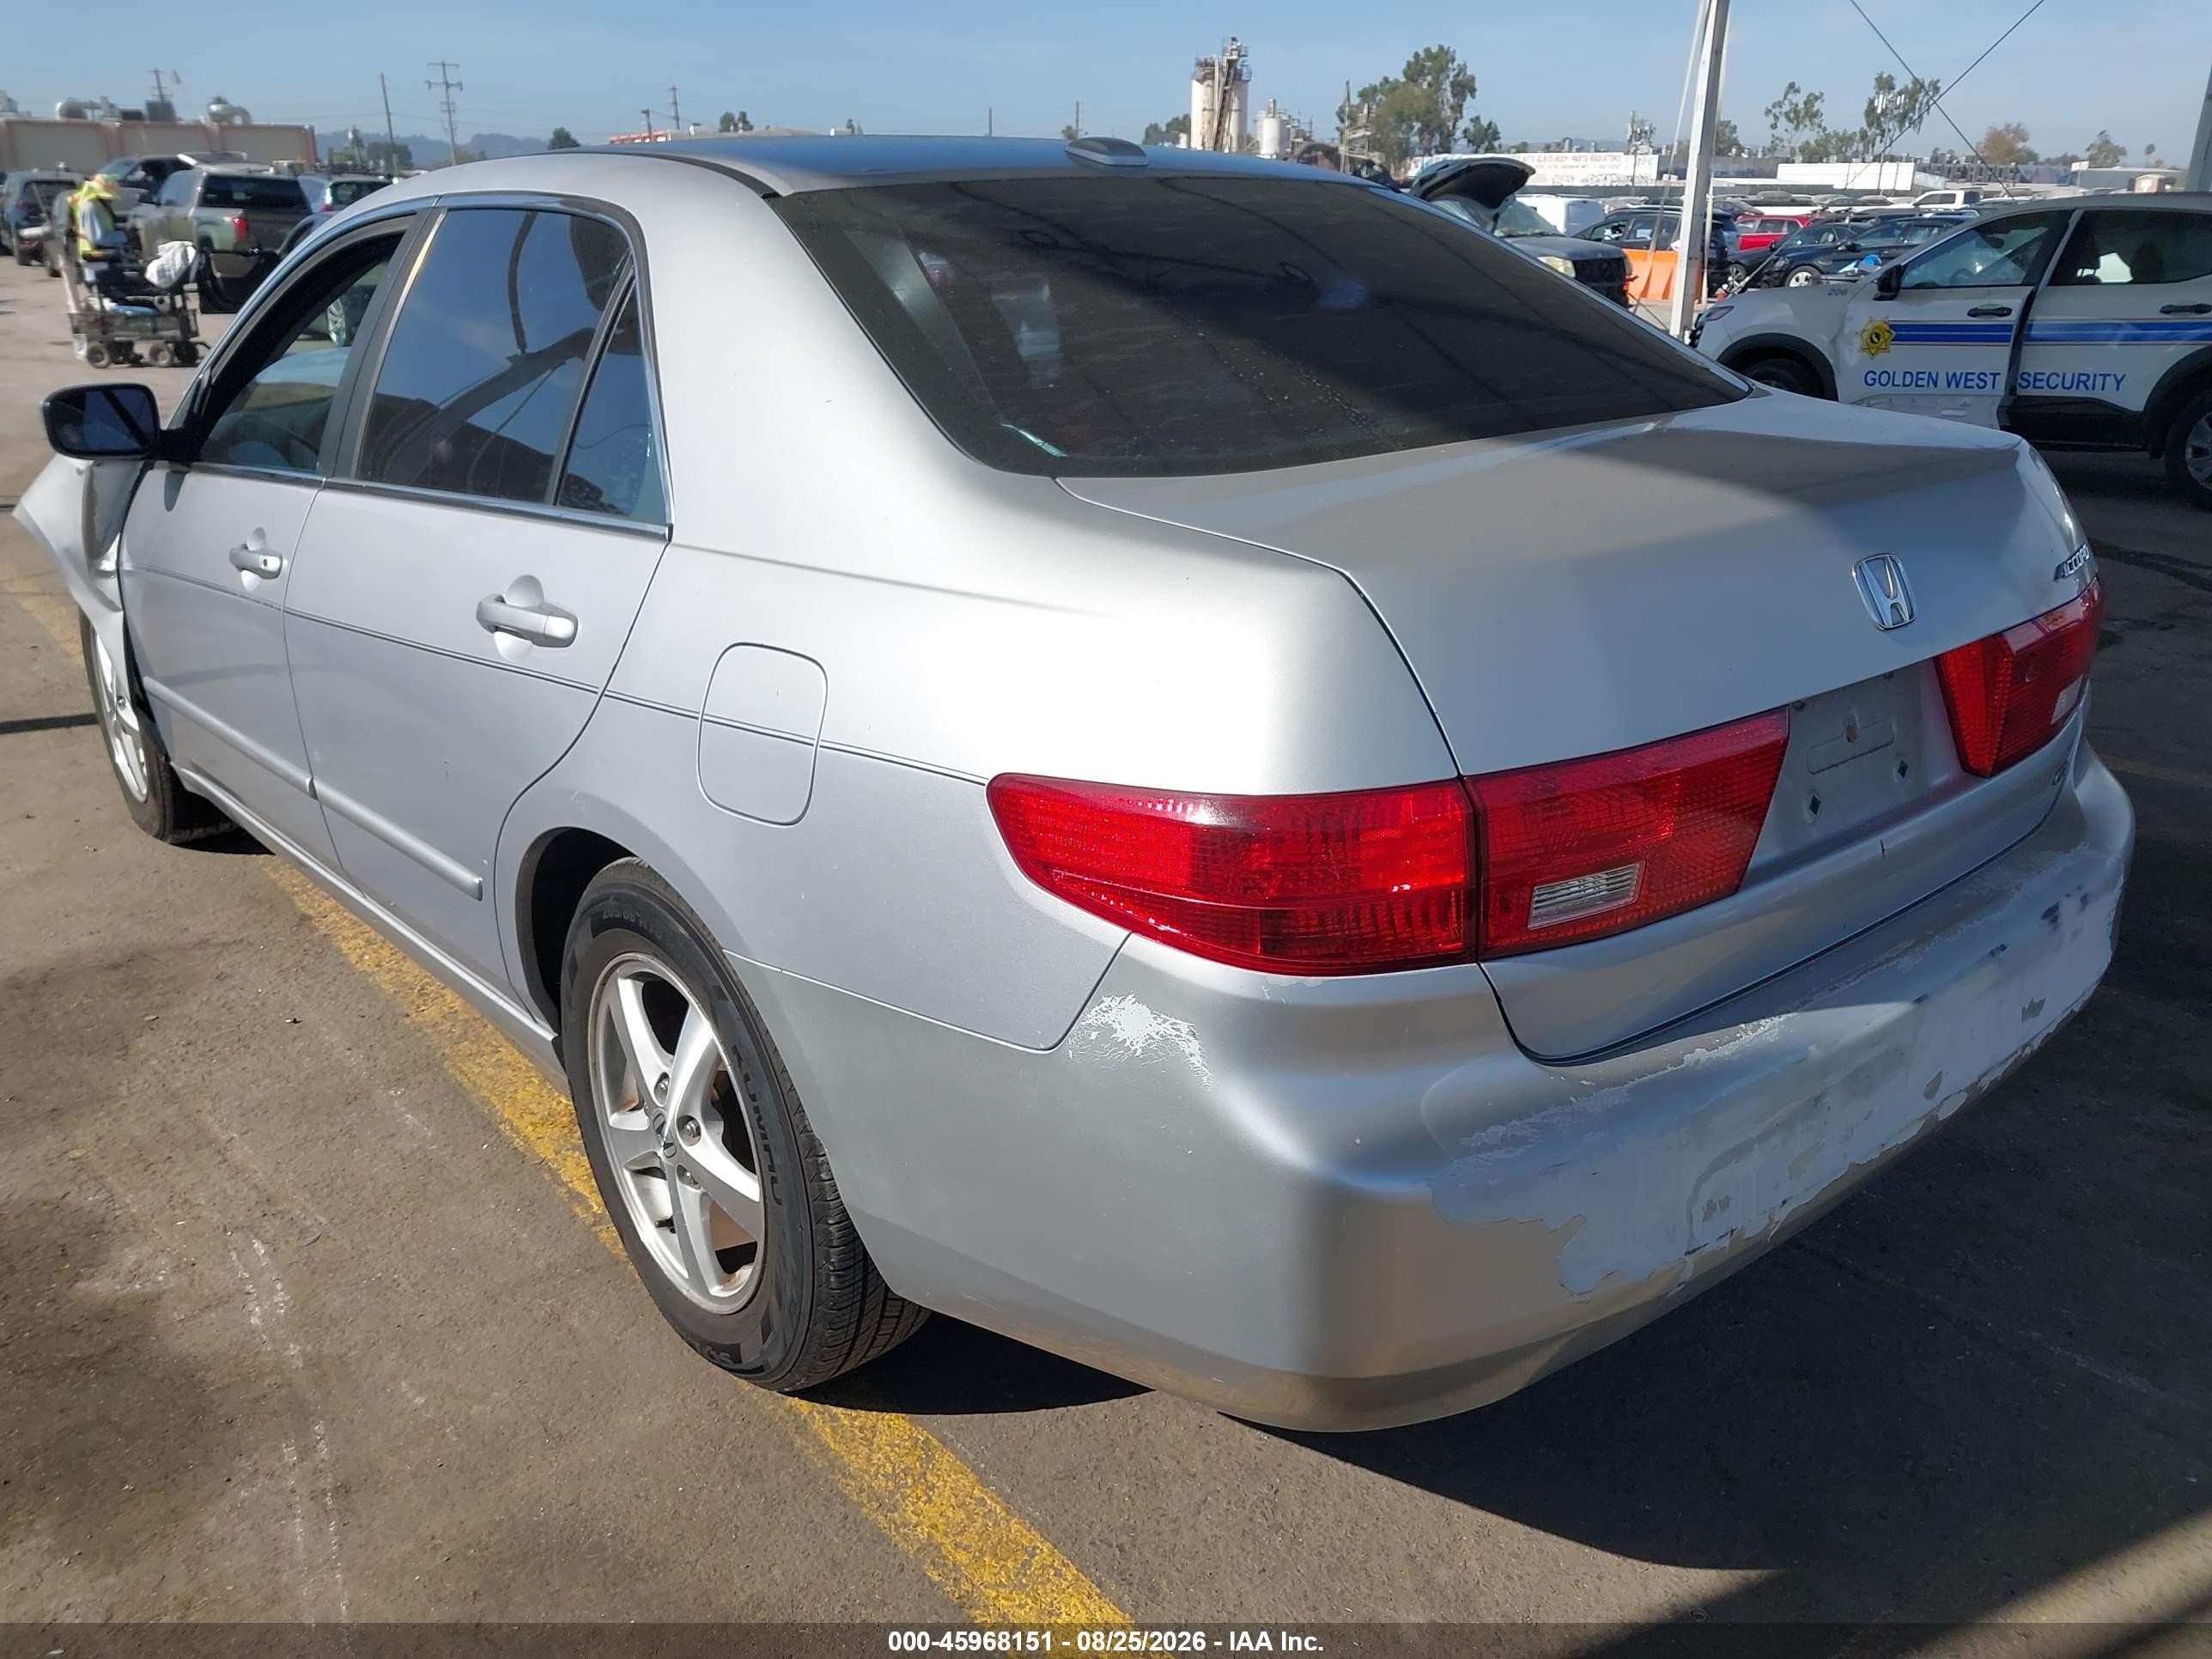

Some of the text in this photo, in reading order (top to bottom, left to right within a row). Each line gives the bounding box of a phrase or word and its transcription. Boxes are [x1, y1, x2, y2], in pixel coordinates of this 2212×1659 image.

[1863, 370, 2127, 392] GOLDEN WEST SECURITY
